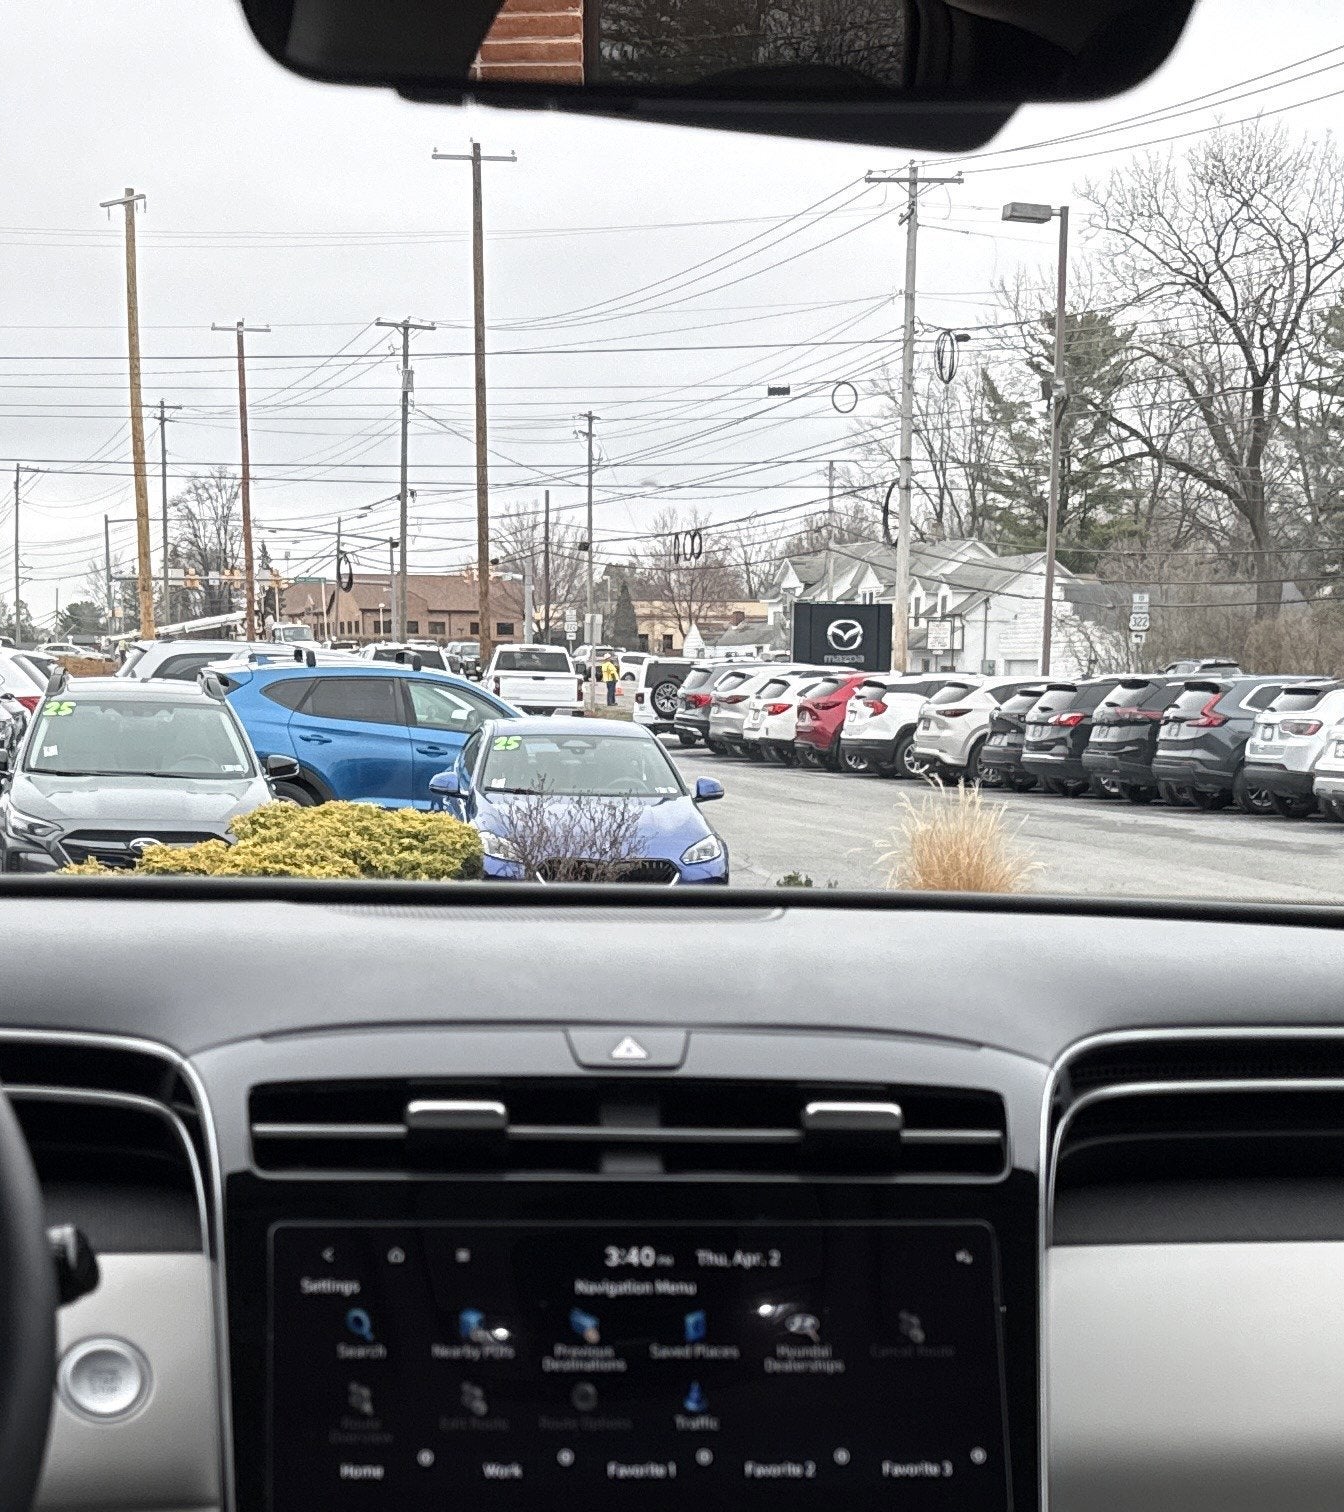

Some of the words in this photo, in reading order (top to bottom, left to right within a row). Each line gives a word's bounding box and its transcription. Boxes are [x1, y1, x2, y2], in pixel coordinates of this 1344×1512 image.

[1132, 616, 1147, 627] 322
[824, 653, 864, 664] mazda
[43, 702, 77, 716] 25
[494, 737, 522, 750] 25
[605, 1246, 656, 1267] 3:40
[769, 1249, 781, 1267] 2
[300, 1278, 361, 1296] Settings
[574, 1279, 654, 1298] Navigation
[654, 1279, 697, 1295] Menu
[336, 1343, 387, 1359] Search
[431, 1344, 481, 1361] Nearby
[553, 1344, 615, 1358] Previous
[649, 1343, 693, 1359] Saved
[692, 1343, 740, 1359] Places
[776, 1344, 833, 1359] Hyundai
[542, 1358, 628, 1373] Destinations
[763, 1358, 846, 1374] Dealerships
[674, 1414, 720, 1430] Traffic
[340, 1464, 385, 1479] Home
[482, 1463, 522, 1478] Work
[606, 1461, 667, 1478] Favorite
[667, 1461, 677, 1477] 1
[744, 1461, 802, 1478] Favorite
[801, 1460, 817, 1478] 2
[881, 1460, 940, 1477] Favorite
[942, 1460, 953, 1477] 3
